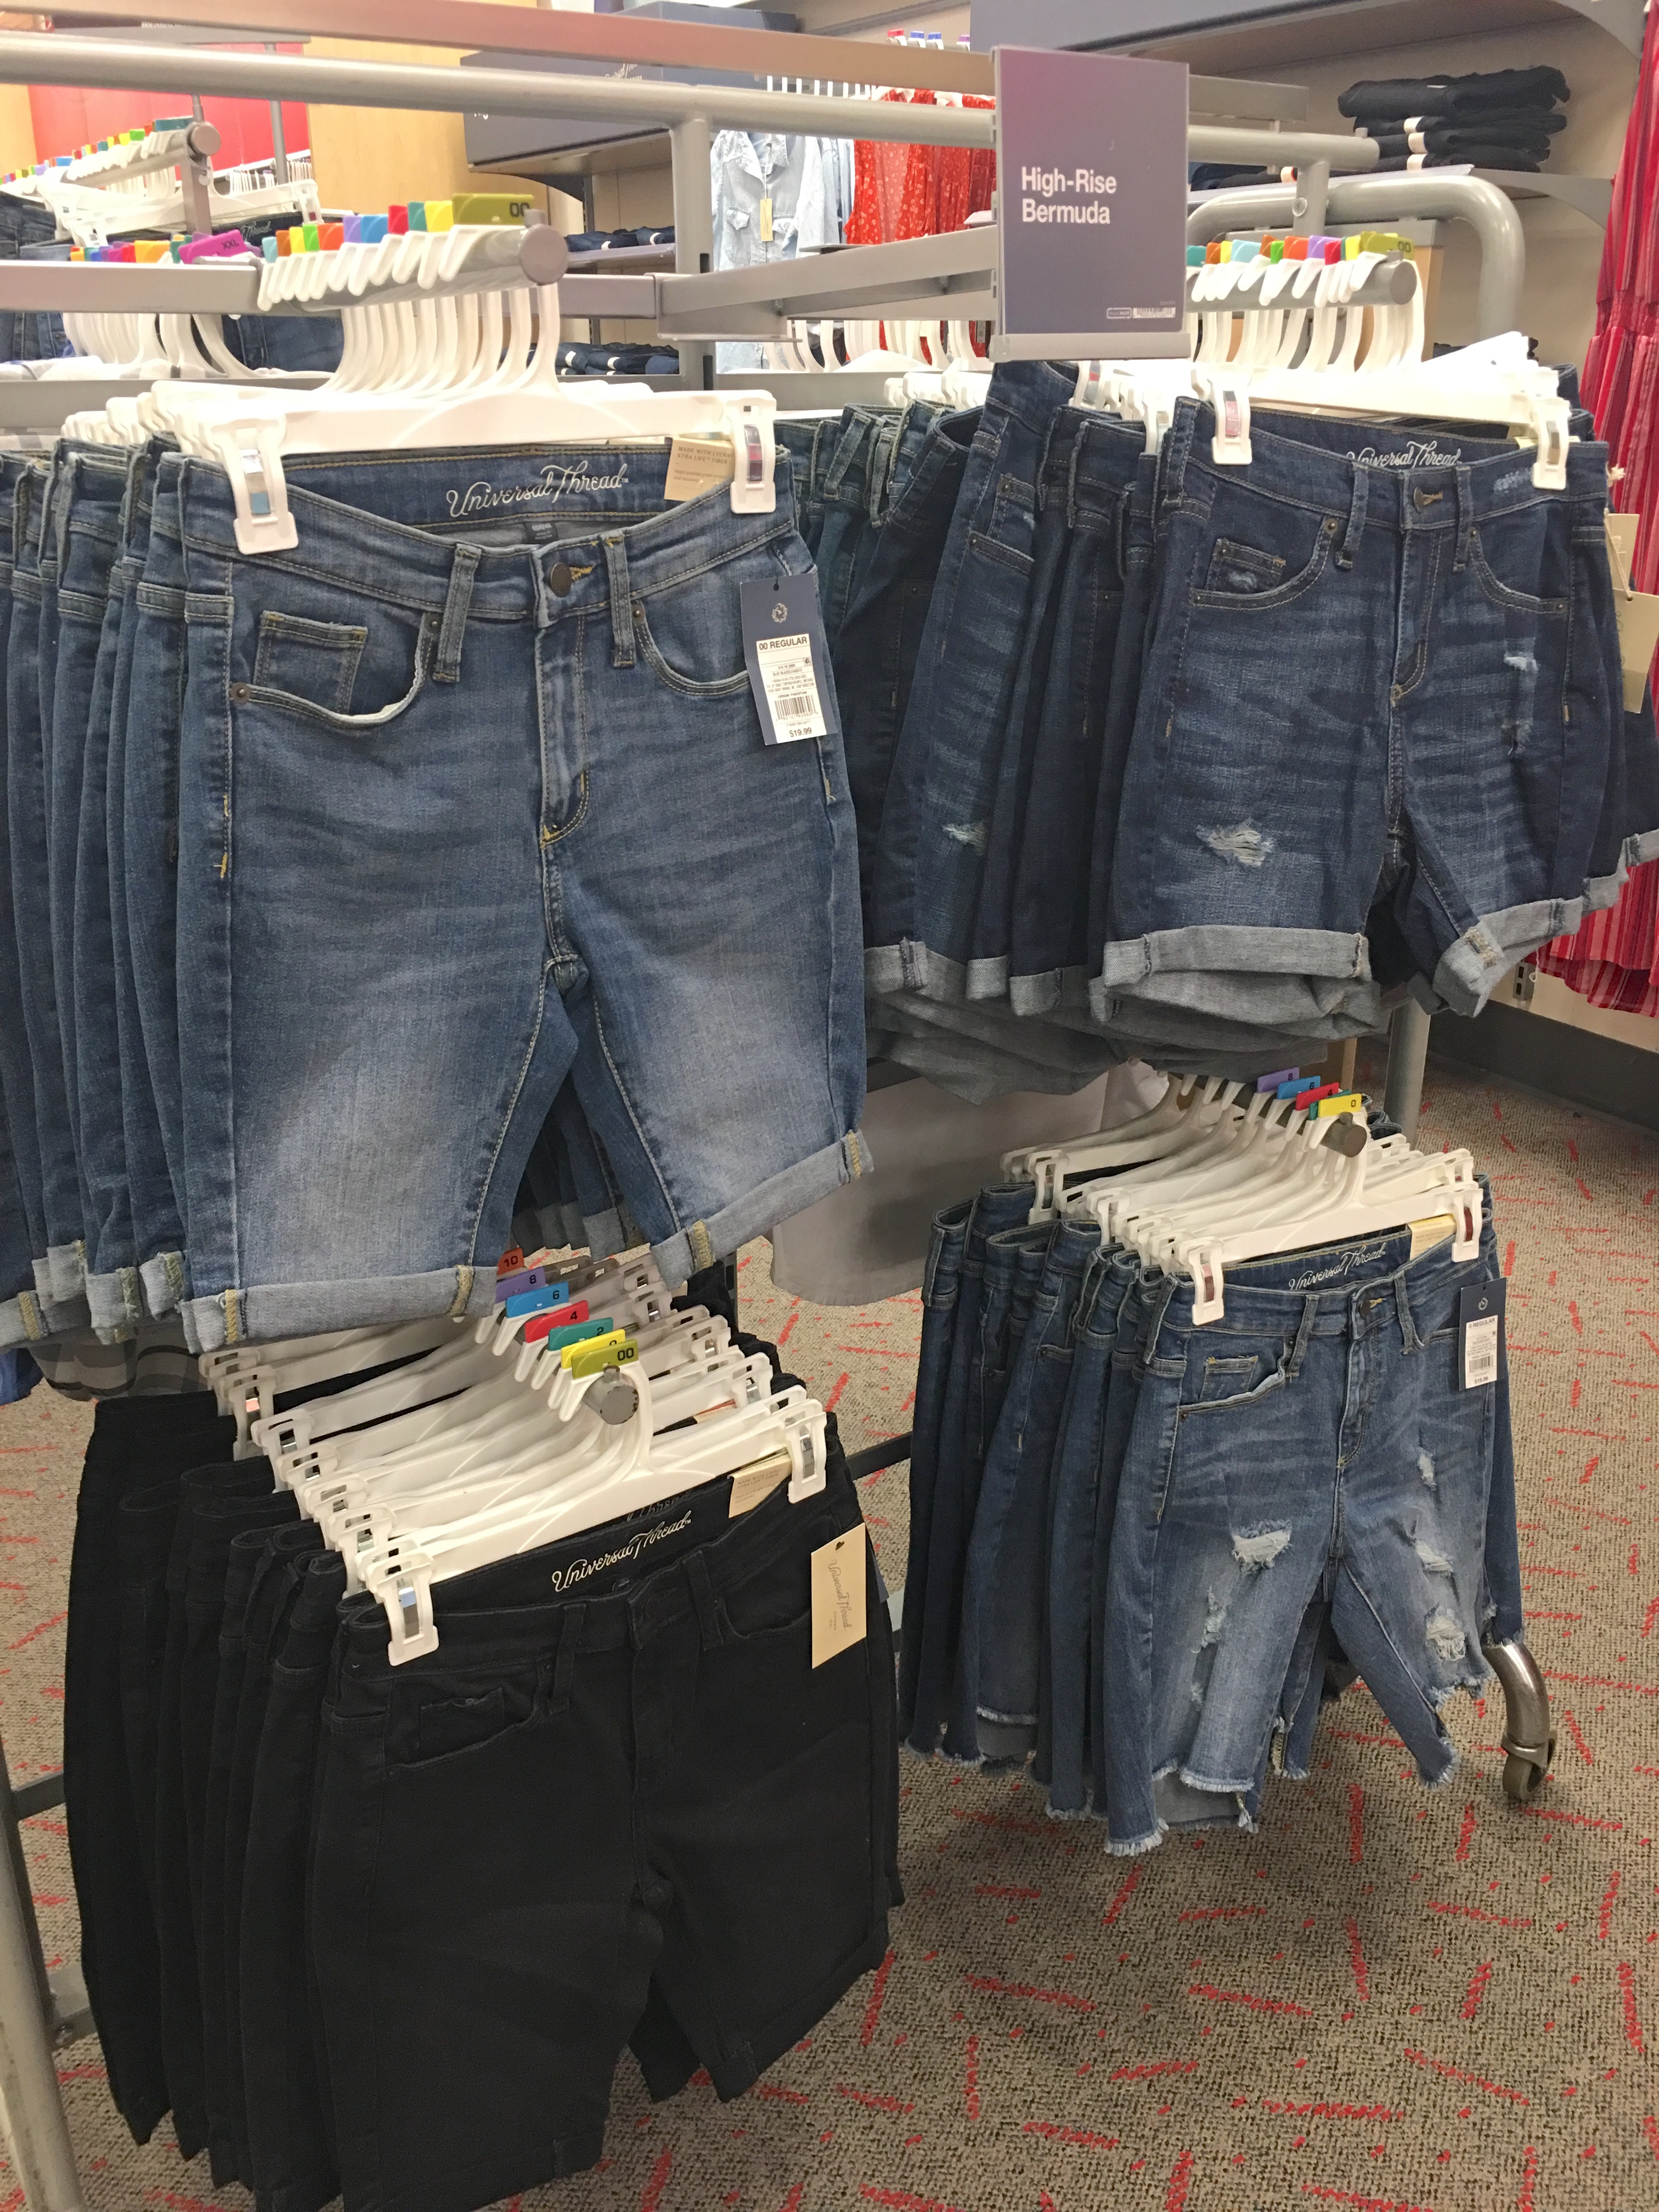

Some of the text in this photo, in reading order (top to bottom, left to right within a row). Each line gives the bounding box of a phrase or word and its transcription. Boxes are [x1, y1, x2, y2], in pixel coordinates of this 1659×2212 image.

[1022, 167, 1116, 197] High-Rise
[1022, 199, 1110, 224] Bermuda
[222, 239, 240, 250] XXL
[1398, 241, 1412, 253] 00
[446, 471, 554, 517] Universal
[759, 636, 808, 651] 00 REGULAR
[789, 727, 812, 738] $19.99
[1288, 1073, 1293, 1081] 8
[1309, 1082, 1314, 1090] 6
[1351, 1099, 1356, 1108] 0
[504, 1255, 518, 1267] 10
[1288, 1256, 1348, 1290] Universal
[529, 1274, 537, 1284] 8
[552, 1290, 560, 1300] 6
[570, 1311, 578, 1320] 4
[1472, 1318, 1495, 1328] REGULAR
[597, 1327, 603, 1336] 2
[617, 1347, 634, 1361] 00
[1474, 1376, 1488, 1384] $19.99
[552, 1537, 639, 1592] Universal
[828, 1559, 853, 1629] Universal Thread
